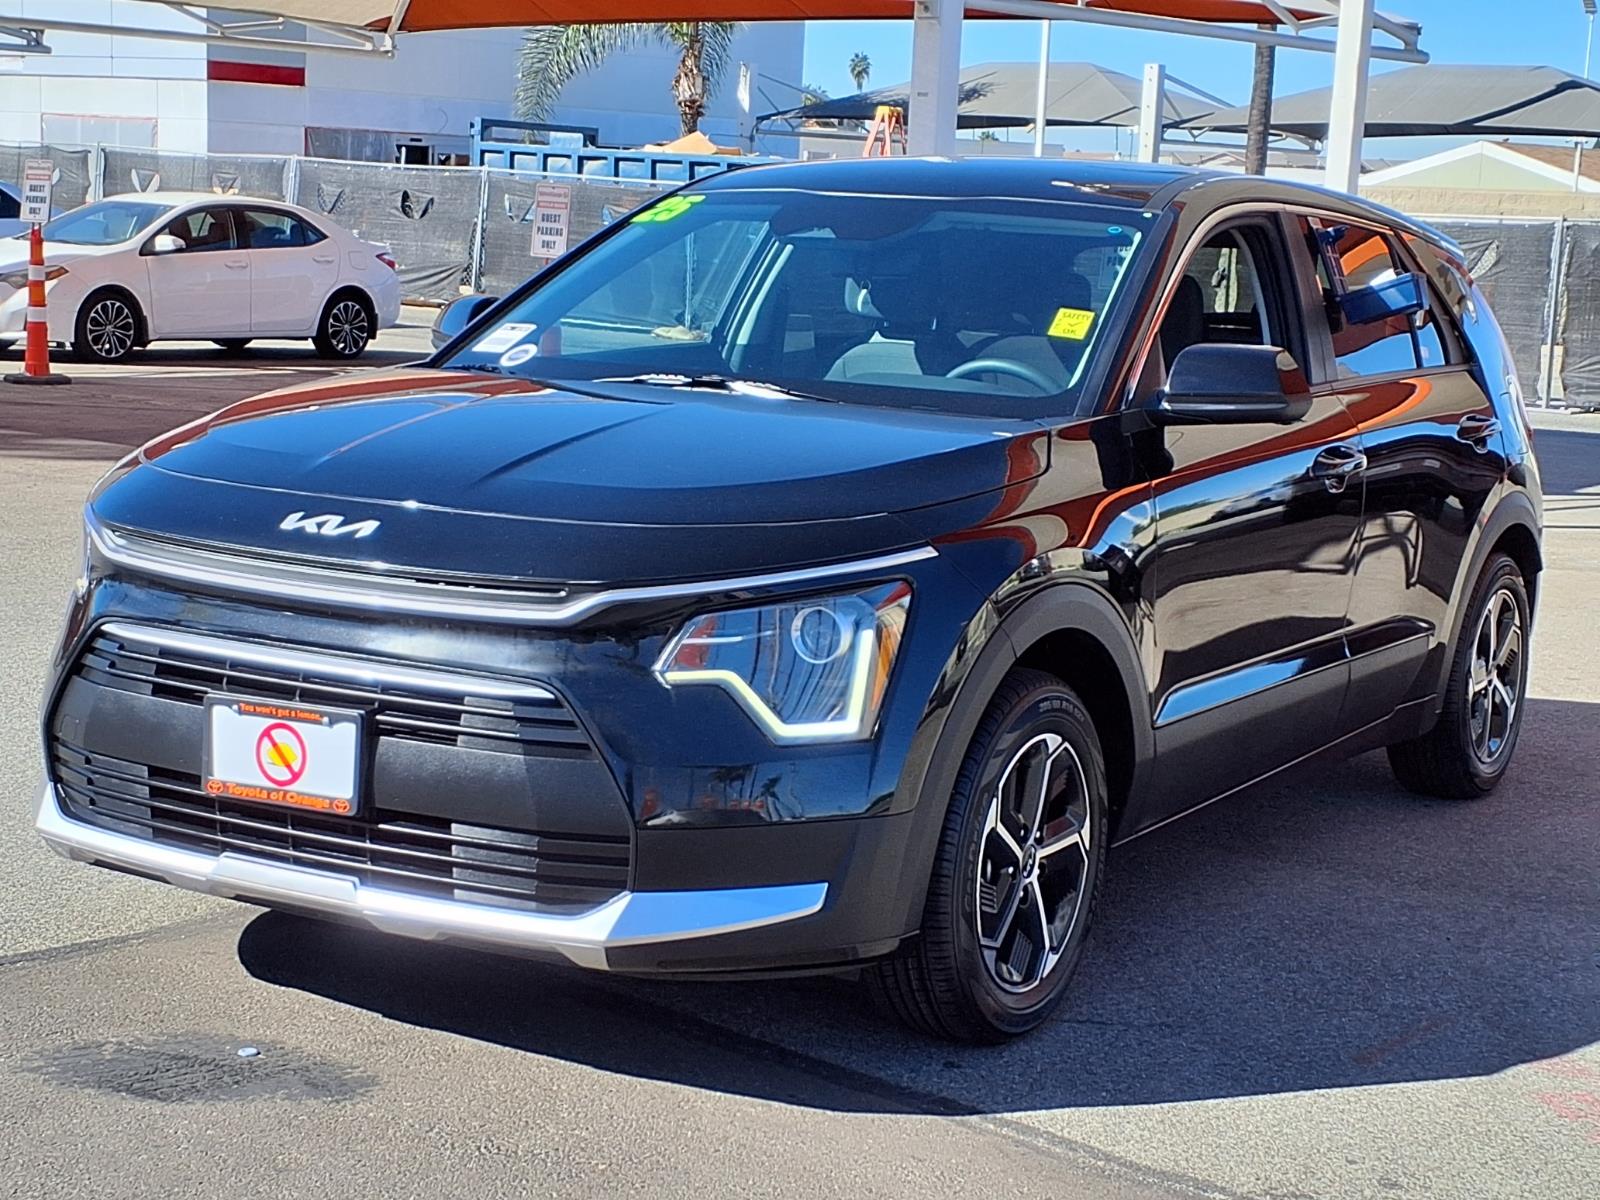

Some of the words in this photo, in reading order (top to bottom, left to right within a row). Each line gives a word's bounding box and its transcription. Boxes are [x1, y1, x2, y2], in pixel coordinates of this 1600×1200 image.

[541, 213, 561, 223] GUEST
[537, 226, 564, 237] PARKING
[541, 239, 557, 249] ONLY
[280, 511, 381, 538] KIA
[239, 702, 254, 712] You
[255, 705, 276, 715] won't
[277, 708, 290, 718] get
[226, 782, 268, 799] Toyota
[269, 790, 284, 801] of
[286, 792, 330, 809] Orange
